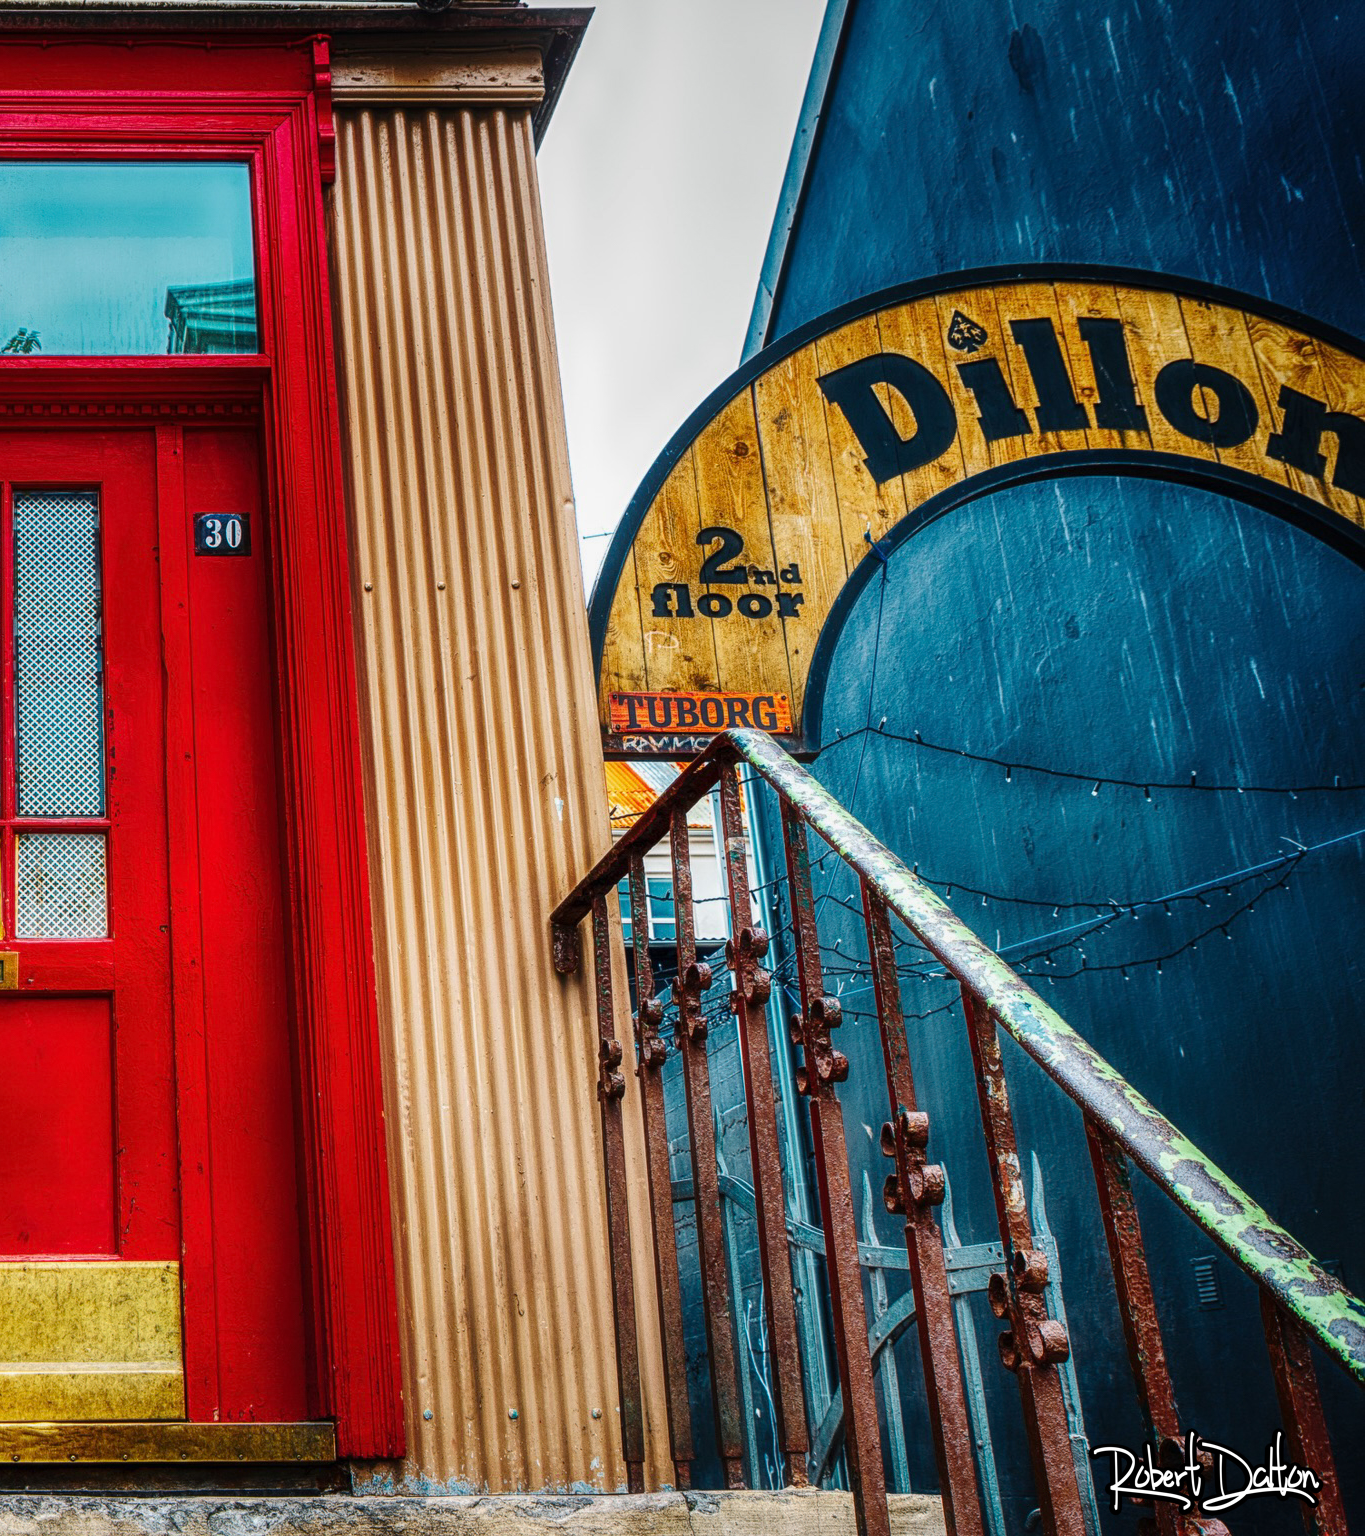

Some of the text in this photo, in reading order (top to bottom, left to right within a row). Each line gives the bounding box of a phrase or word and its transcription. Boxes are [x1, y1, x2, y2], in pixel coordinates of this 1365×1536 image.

[205, 519, 242, 548] 30
[696, 527, 802, 585] 2nd
[651, 582, 804, 619] floor
[618, 694, 778, 731] TUBORG
